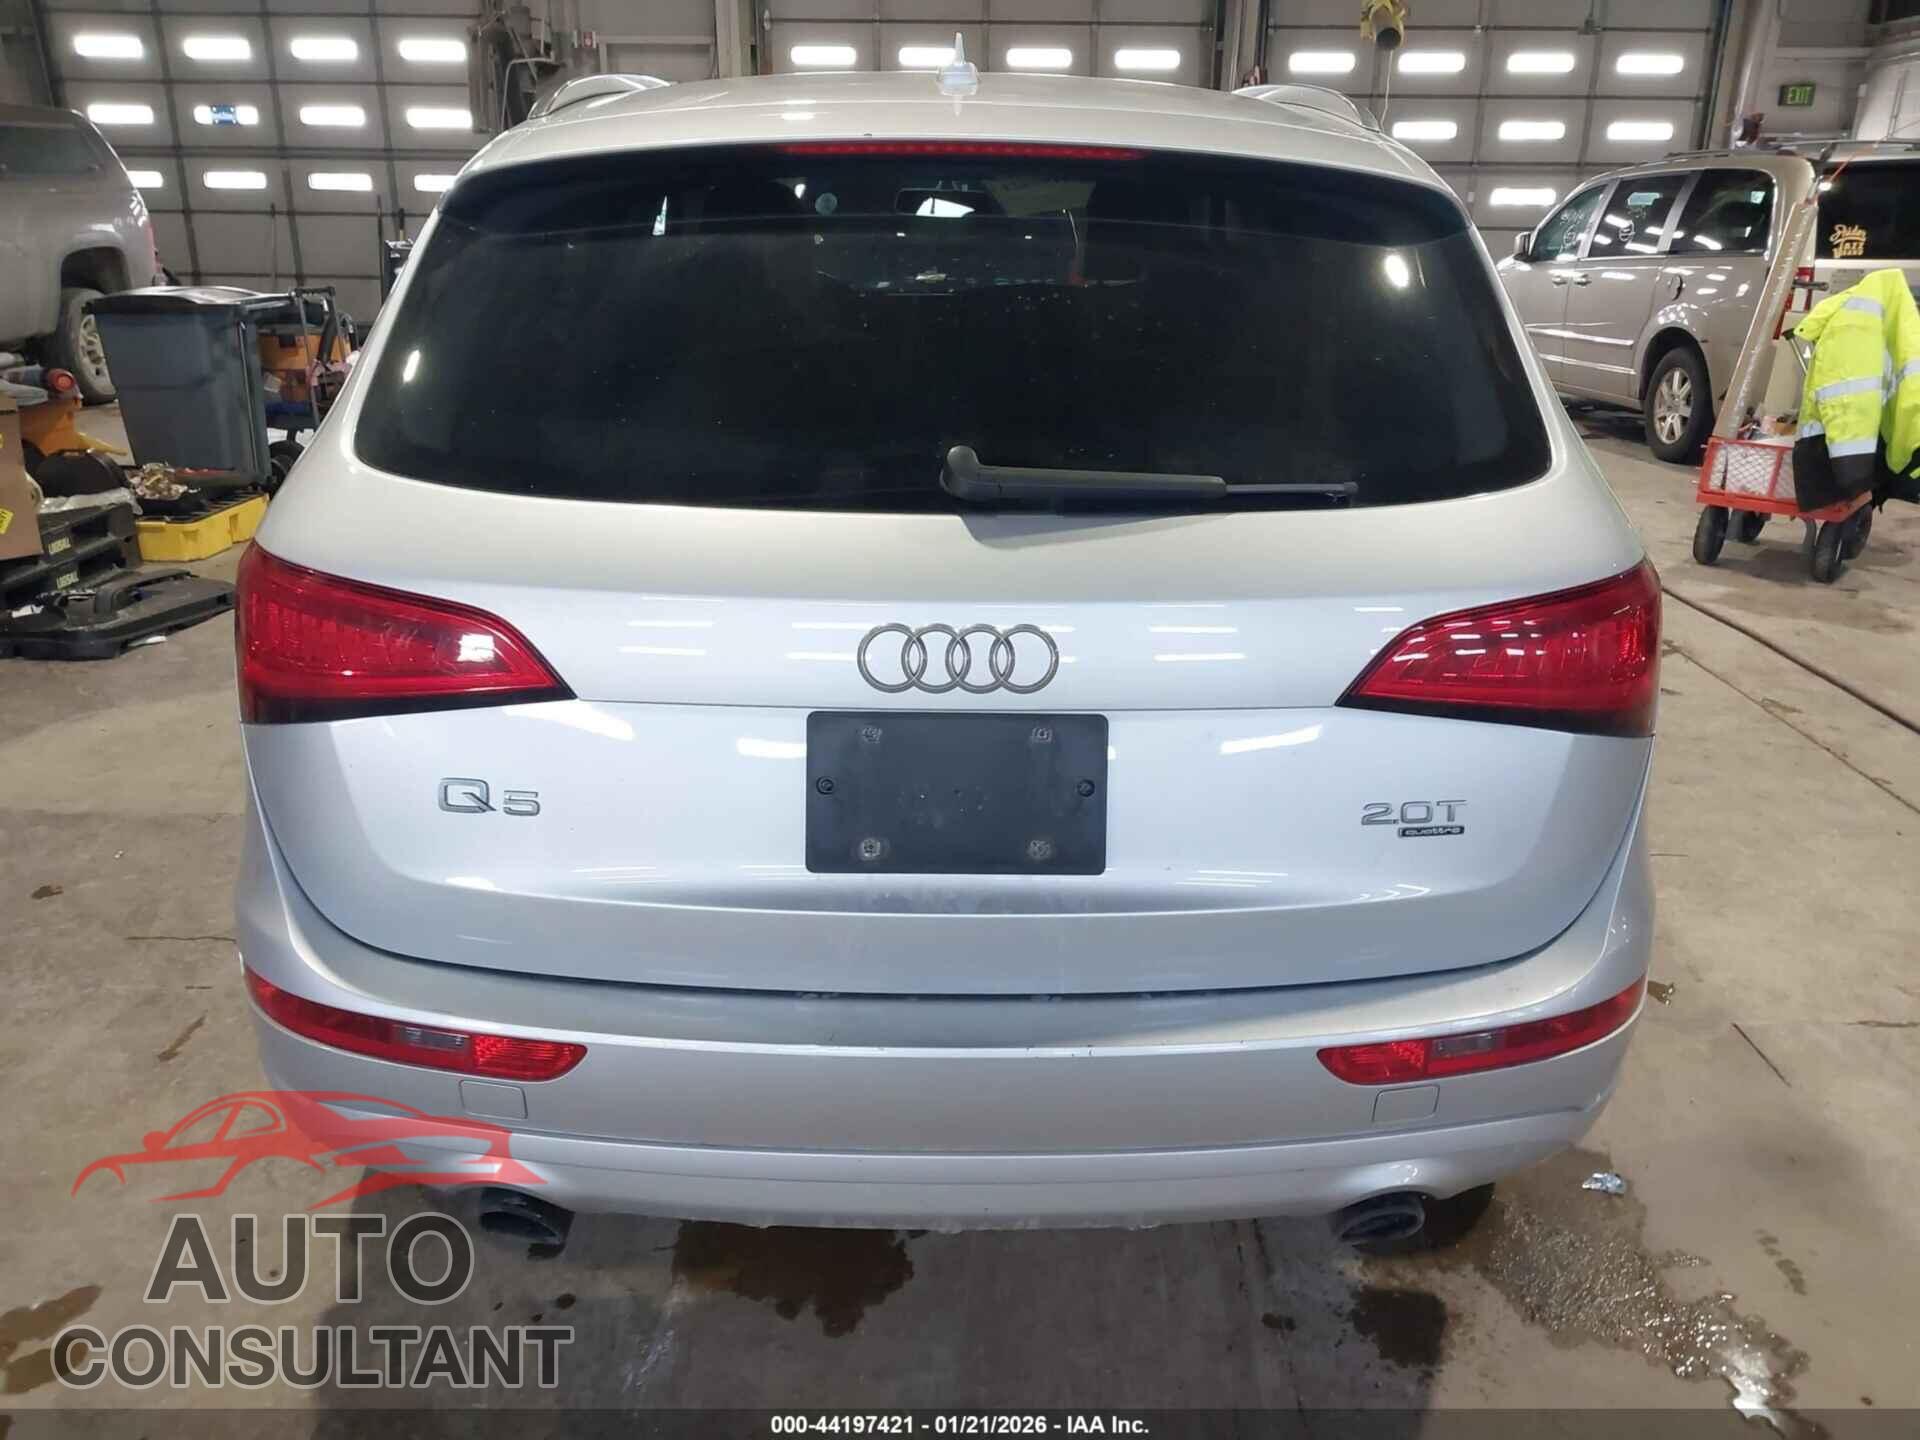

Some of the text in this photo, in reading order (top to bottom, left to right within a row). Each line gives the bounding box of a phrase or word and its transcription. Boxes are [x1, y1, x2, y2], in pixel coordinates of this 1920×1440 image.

[1786, 86, 1813, 105] EXIT
[438, 777, 540, 816] Q5
[1361, 799, 1467, 825] 2.0T
[1402, 826, 1463, 837] quattro
